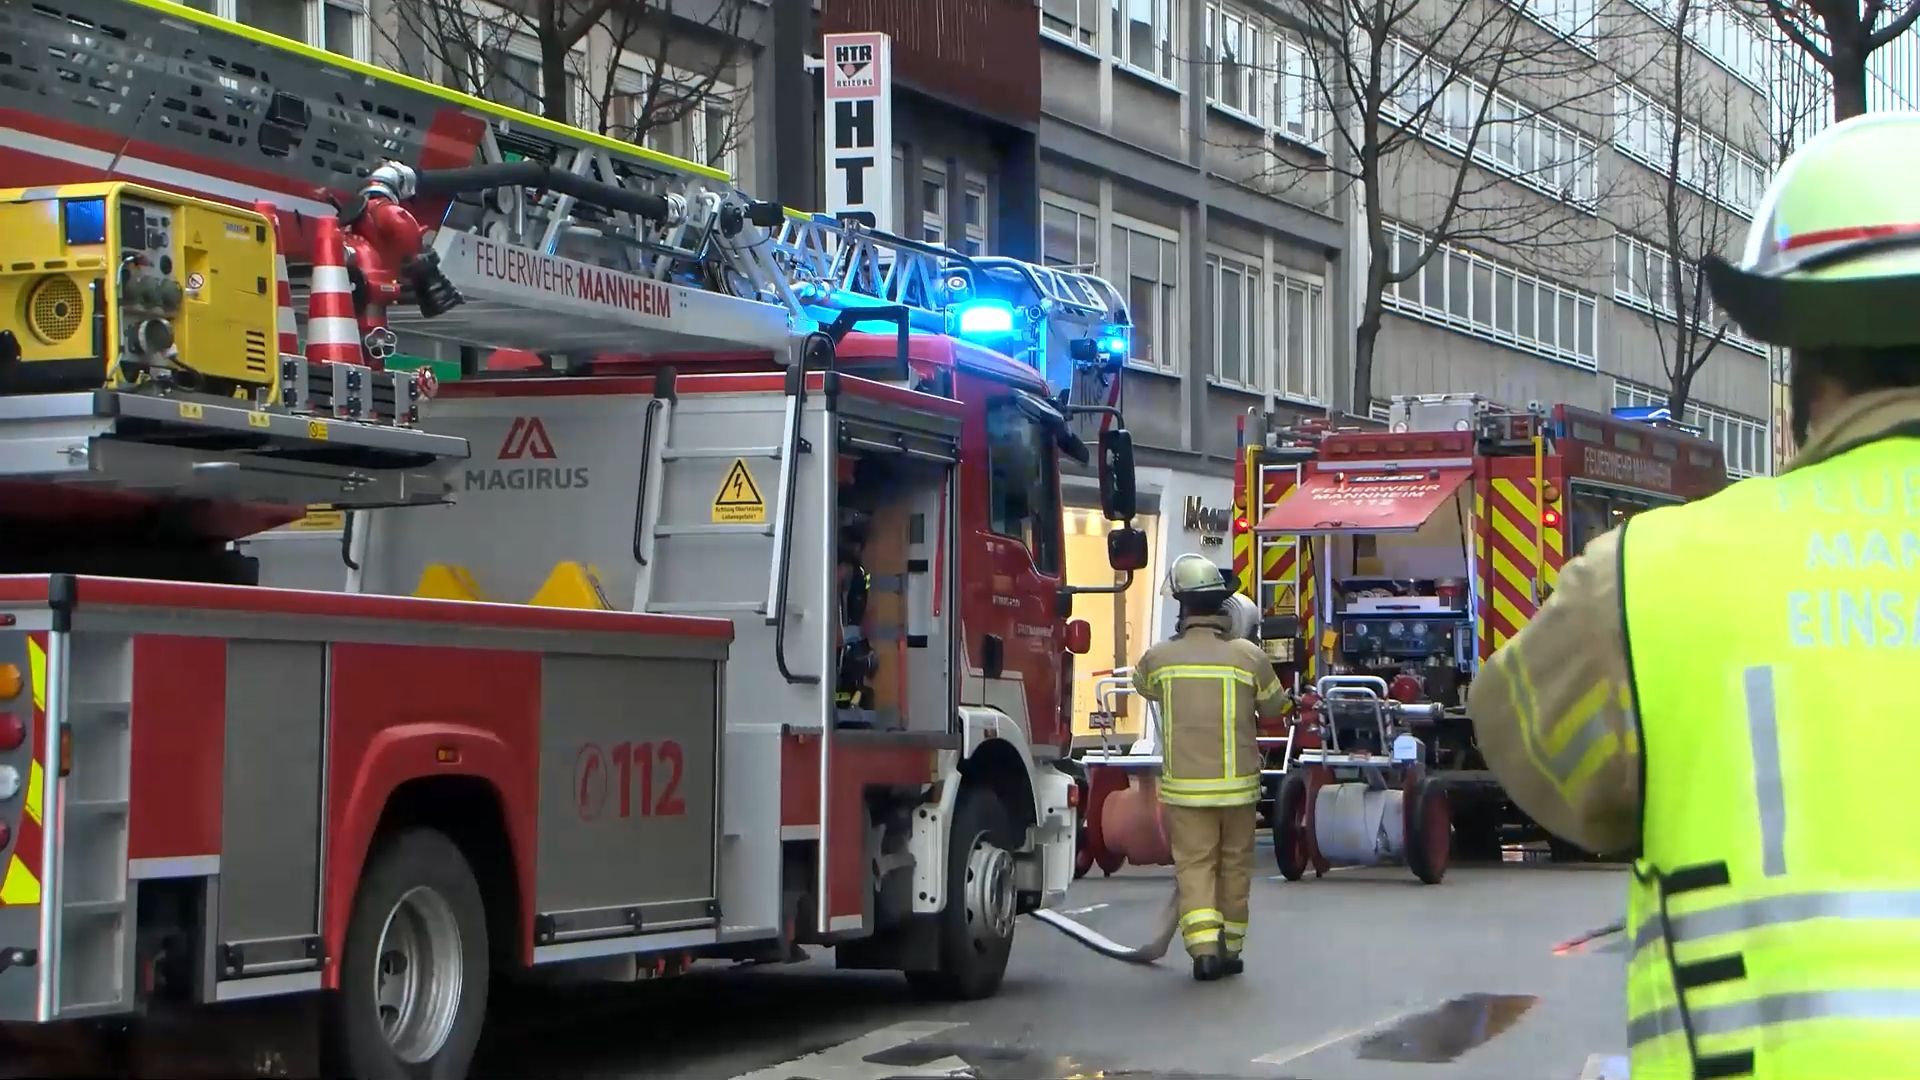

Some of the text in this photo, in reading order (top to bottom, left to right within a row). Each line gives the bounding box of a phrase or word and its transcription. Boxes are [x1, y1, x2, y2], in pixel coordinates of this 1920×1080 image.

[836, 45, 872, 62] HTR
[476, 241, 671, 318] FEUERWEHR MANNHEIM
[465, 468, 589, 491] MAGIRUS
[1311, 484, 1441, 494] FEUERWEHR
[1312, 491, 1425, 500] MANNHEIM
[1787, 590, 1920, 646] EINS
[611, 740, 685, 817] 112
